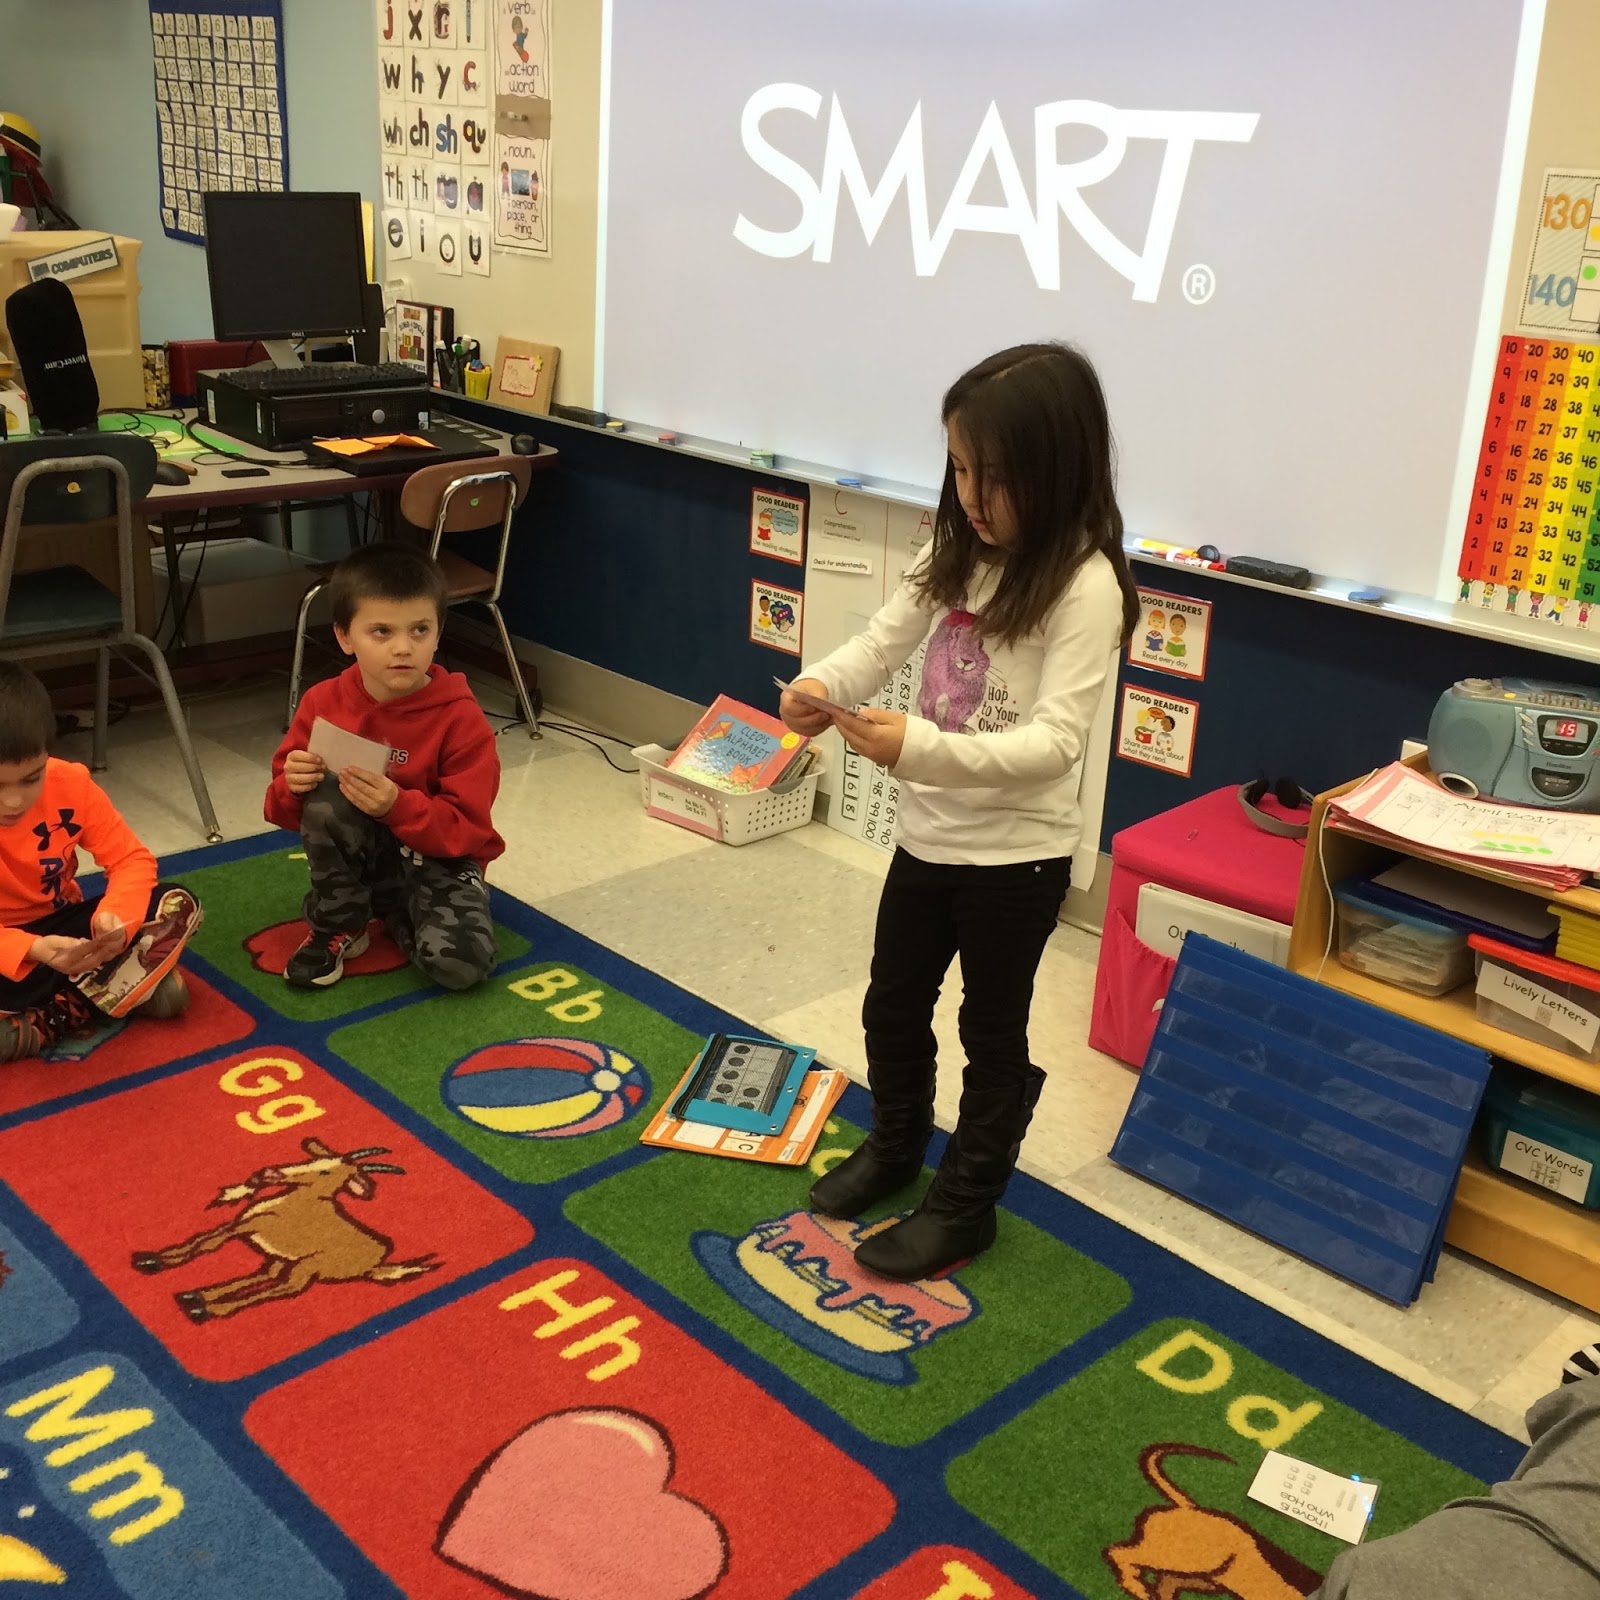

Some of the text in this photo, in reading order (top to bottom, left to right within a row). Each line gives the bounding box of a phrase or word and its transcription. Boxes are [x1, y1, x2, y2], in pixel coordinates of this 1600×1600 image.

[508, 0, 530, 14] verb
[408, 9, 422, 41] x
[382, 60, 400, 90] w
[412, 54, 424, 94] h
[436, 65, 450, 100] y
[510, 62, 539, 76] action
[509, 79, 534, 94] word
[384, 108, 486, 154] wh ch sh qu
[508, 146, 532, 158] noun
[385, 164, 428, 202] th th
[732, 82, 1262, 304] SMART
[1544, 194, 1592, 230] 130
[388, 218, 482, 263] e i o u
[51, 248, 114, 274] COMPUTERS
[1528, 274, 1578, 308] 140
[44, 354, 87, 370] HoverCam
[1506, 342, 1594, 363] 10 20 30 40
[1503, 367, 1589, 389] 9 19 29 39
[1498, 392, 1582, 415] 8 18 28 38
[1496, 416, 1600, 443] 7 17 27 37 47
[1489, 441, 1597, 469] 6 16 26 36 46
[1485, 465, 1592, 494] 5 15 25 35 45
[756, 494, 799, 511] GOOD READERS
[835, 490, 848, 515] C
[1480, 489, 1587, 518] 4 14 24 34 44
[918, 510, 934, 534] A
[1475, 514, 1582, 542] 3 13 23 33 43
[836, 561, 868, 571] understanding
[1471, 537, 1600, 572] 2 12 22 32 42 52
[1468, 561, 1595, 596] 1 11 21 31 41 51
[756, 586, 798, 604] GOOD READERS
[1141, 596, 1202, 616] GOOD READERS
[1142, 650, 1157, 661] Read
[1159, 656, 1175, 667] every
[981, 702, 1020, 724] to Your
[1129, 692, 1152, 705] GOOD
[1154, 699, 1189, 715] READERS
[740, 726, 771, 746] CLEO'S
[978, 718, 1004, 733] Own
[1560, 724, 1576, 736] 15
[724, 733, 771, 760] ALPHABET
[726, 747, 752, 766] BOOK
[880, 662, 912, 845] 82 83 88 89 90
[1123, 746, 1138, 755] what
[1139, 749, 1151, 760] they
[1124, 737, 1184, 761] Share and talk about
[866, 781, 884, 839] 98 99 100
[1454, 801, 1560, 825] April 2017
[507, 968, 604, 1023] Bb
[1503, 976, 1588, 1026] Lively Letters
[218, 1057, 326, 1134] Gg
[1515, 1141, 1585, 1177] CVC Words
[498, 1268, 641, 1383] Hh
[1136, 1328, 1324, 1449] Dd
[4, 1364, 184, 1546] Mm
[1292, 1506, 1323, 1528] have
